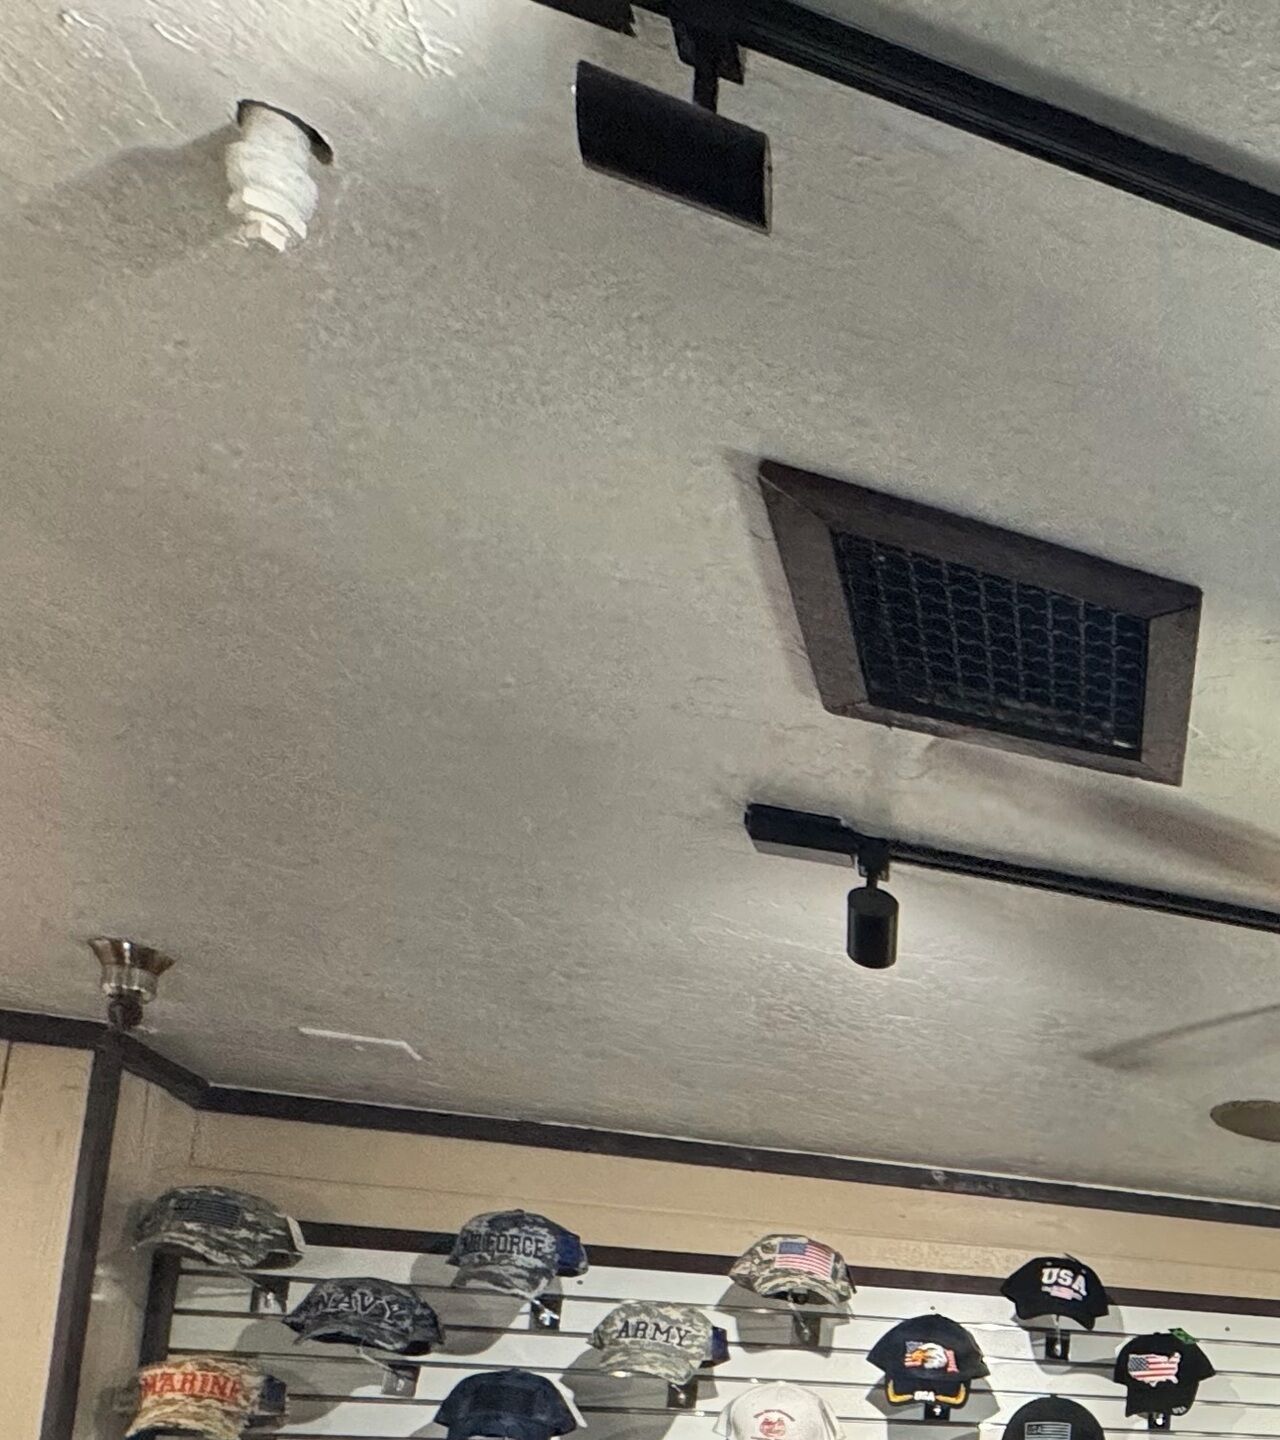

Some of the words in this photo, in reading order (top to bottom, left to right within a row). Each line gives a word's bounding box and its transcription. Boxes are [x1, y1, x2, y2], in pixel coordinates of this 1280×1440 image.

[487, 1233, 545, 1260] FORCE
[1041, 1266, 1088, 1297] USA
[615, 1319, 691, 1347] ARMY
[914, 1390, 936, 1402] USA
